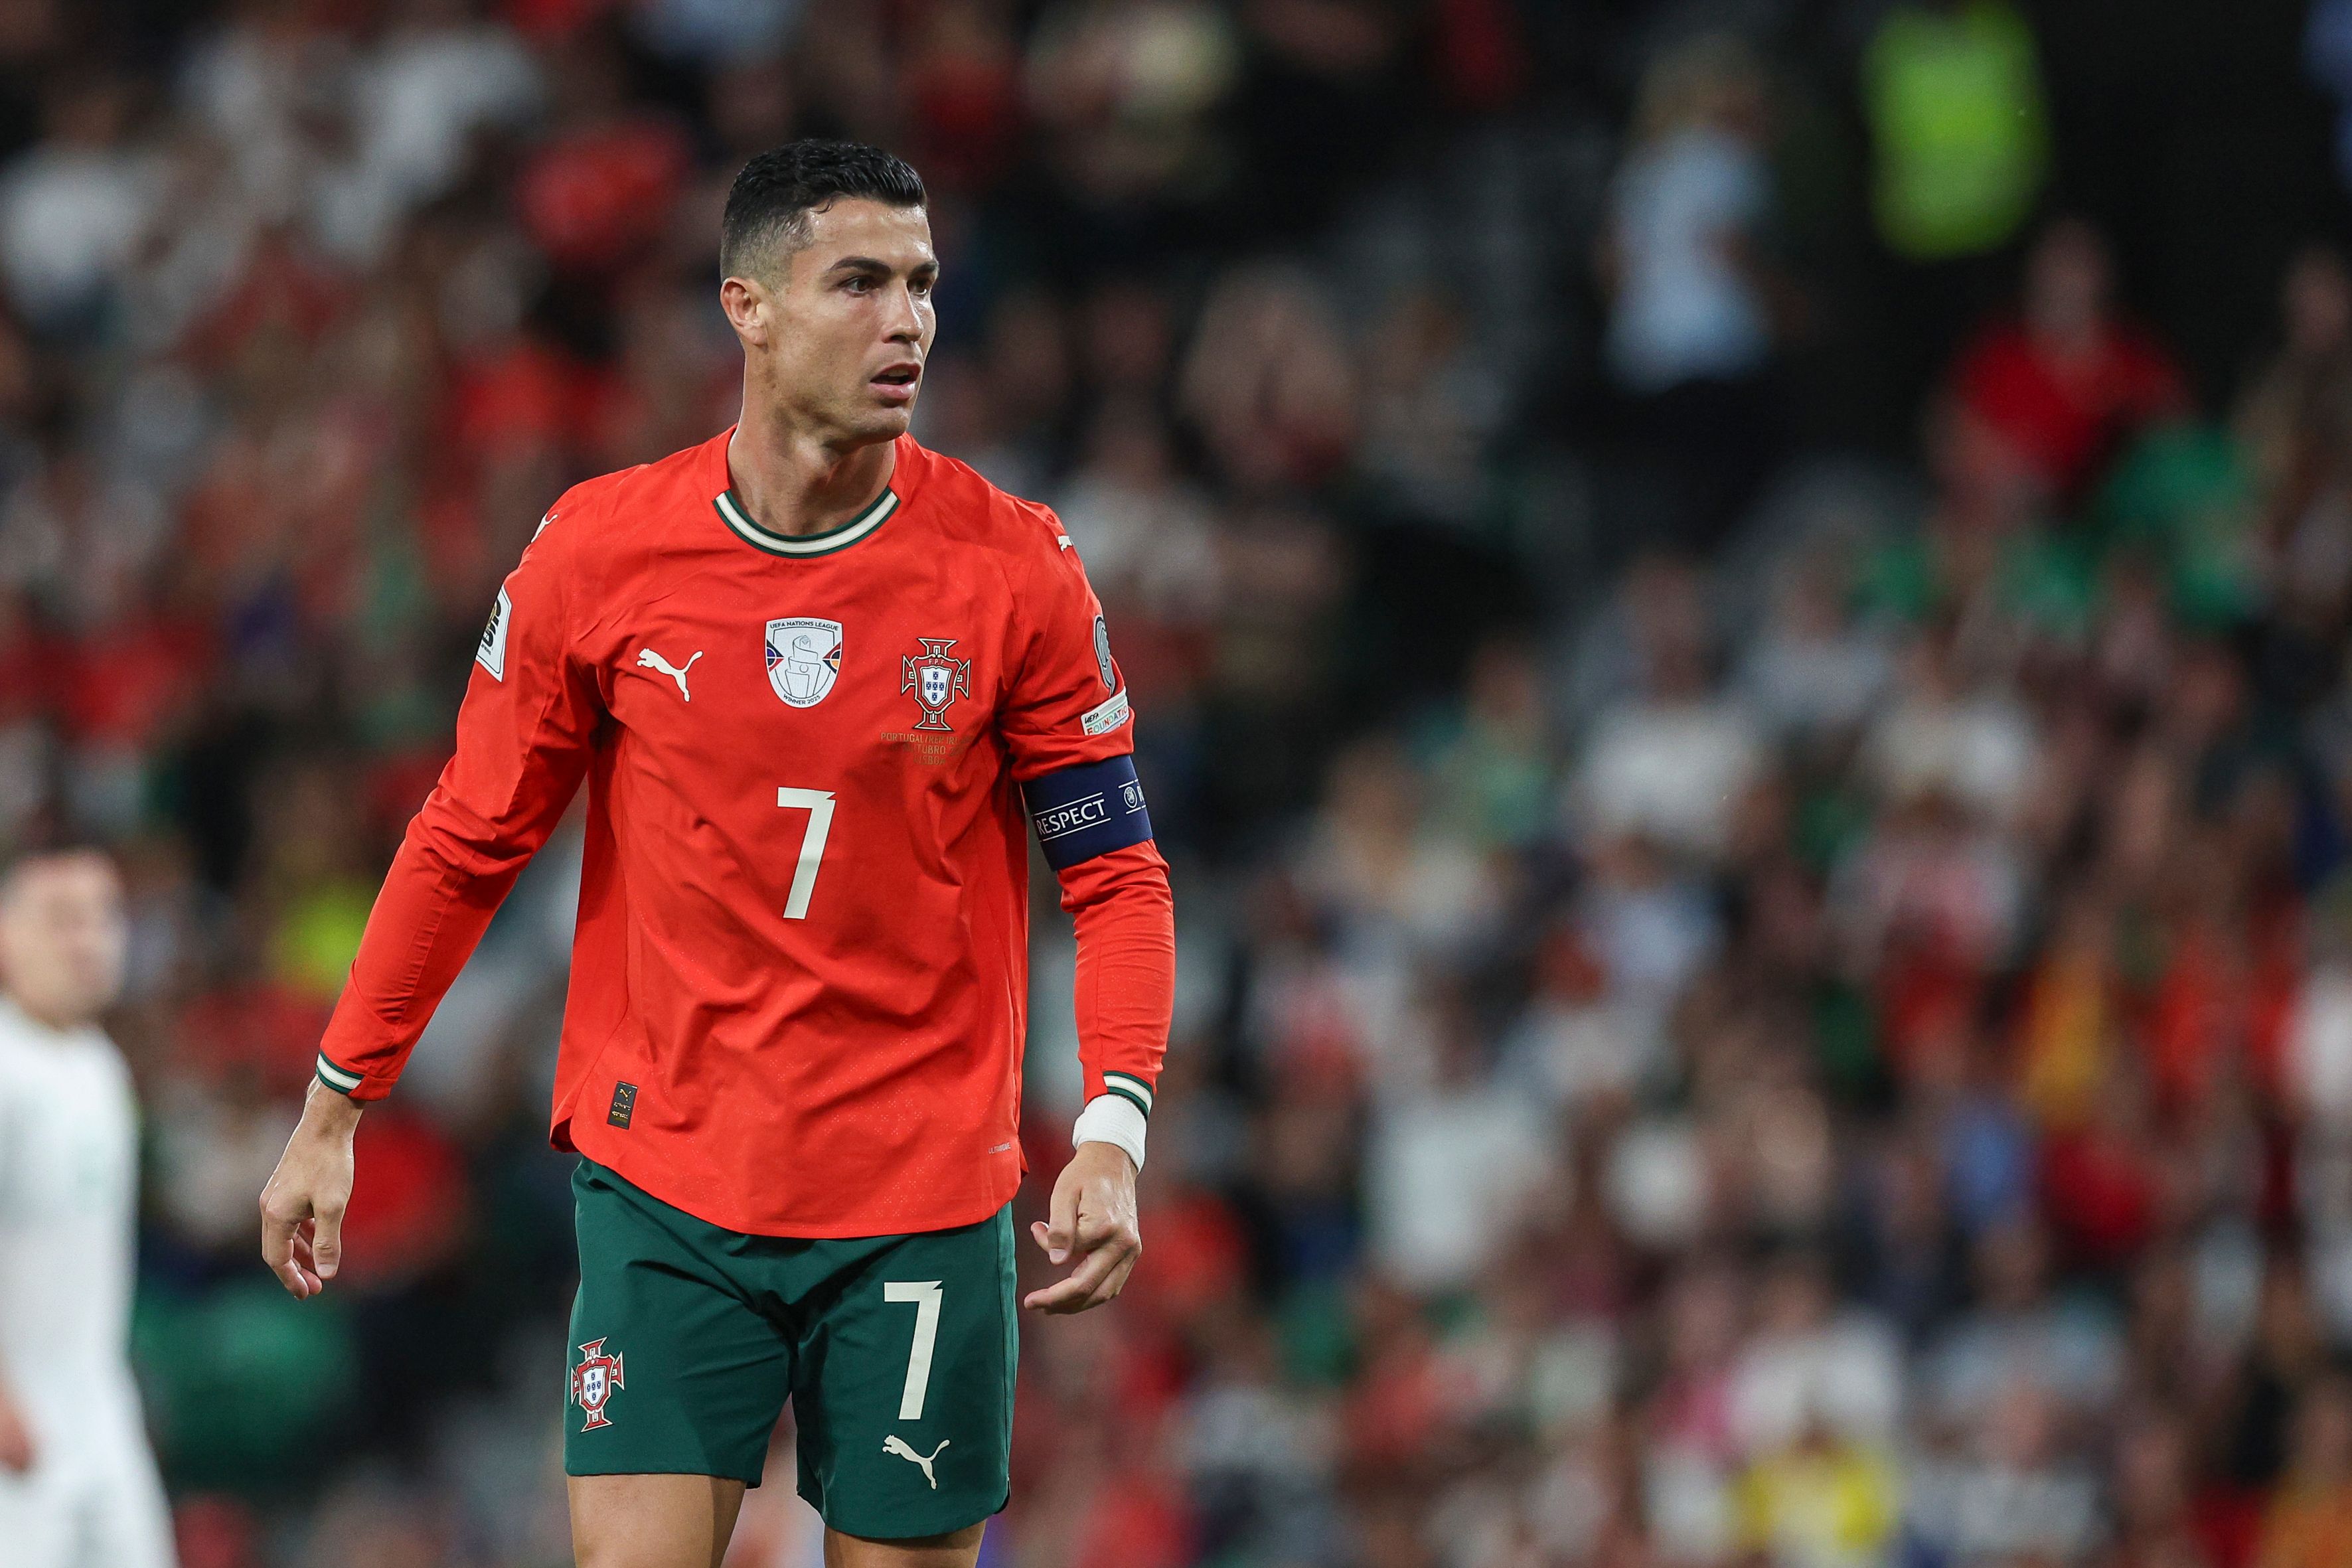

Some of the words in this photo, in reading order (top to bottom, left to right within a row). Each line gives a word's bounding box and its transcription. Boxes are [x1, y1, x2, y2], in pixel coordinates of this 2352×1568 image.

[815, 622, 838, 631] LEAGUE
[784, 694, 806, 704] WINNER
[807, 695, 821, 704] 2025
[1085, 712, 1099, 724] UEFA
[1087, 705, 1128, 736] FOUNDATIO
[1036, 799, 1105, 835] RESPECT
[777, 787, 836, 919] 7
[884, 1280, 943, 1419] 7
